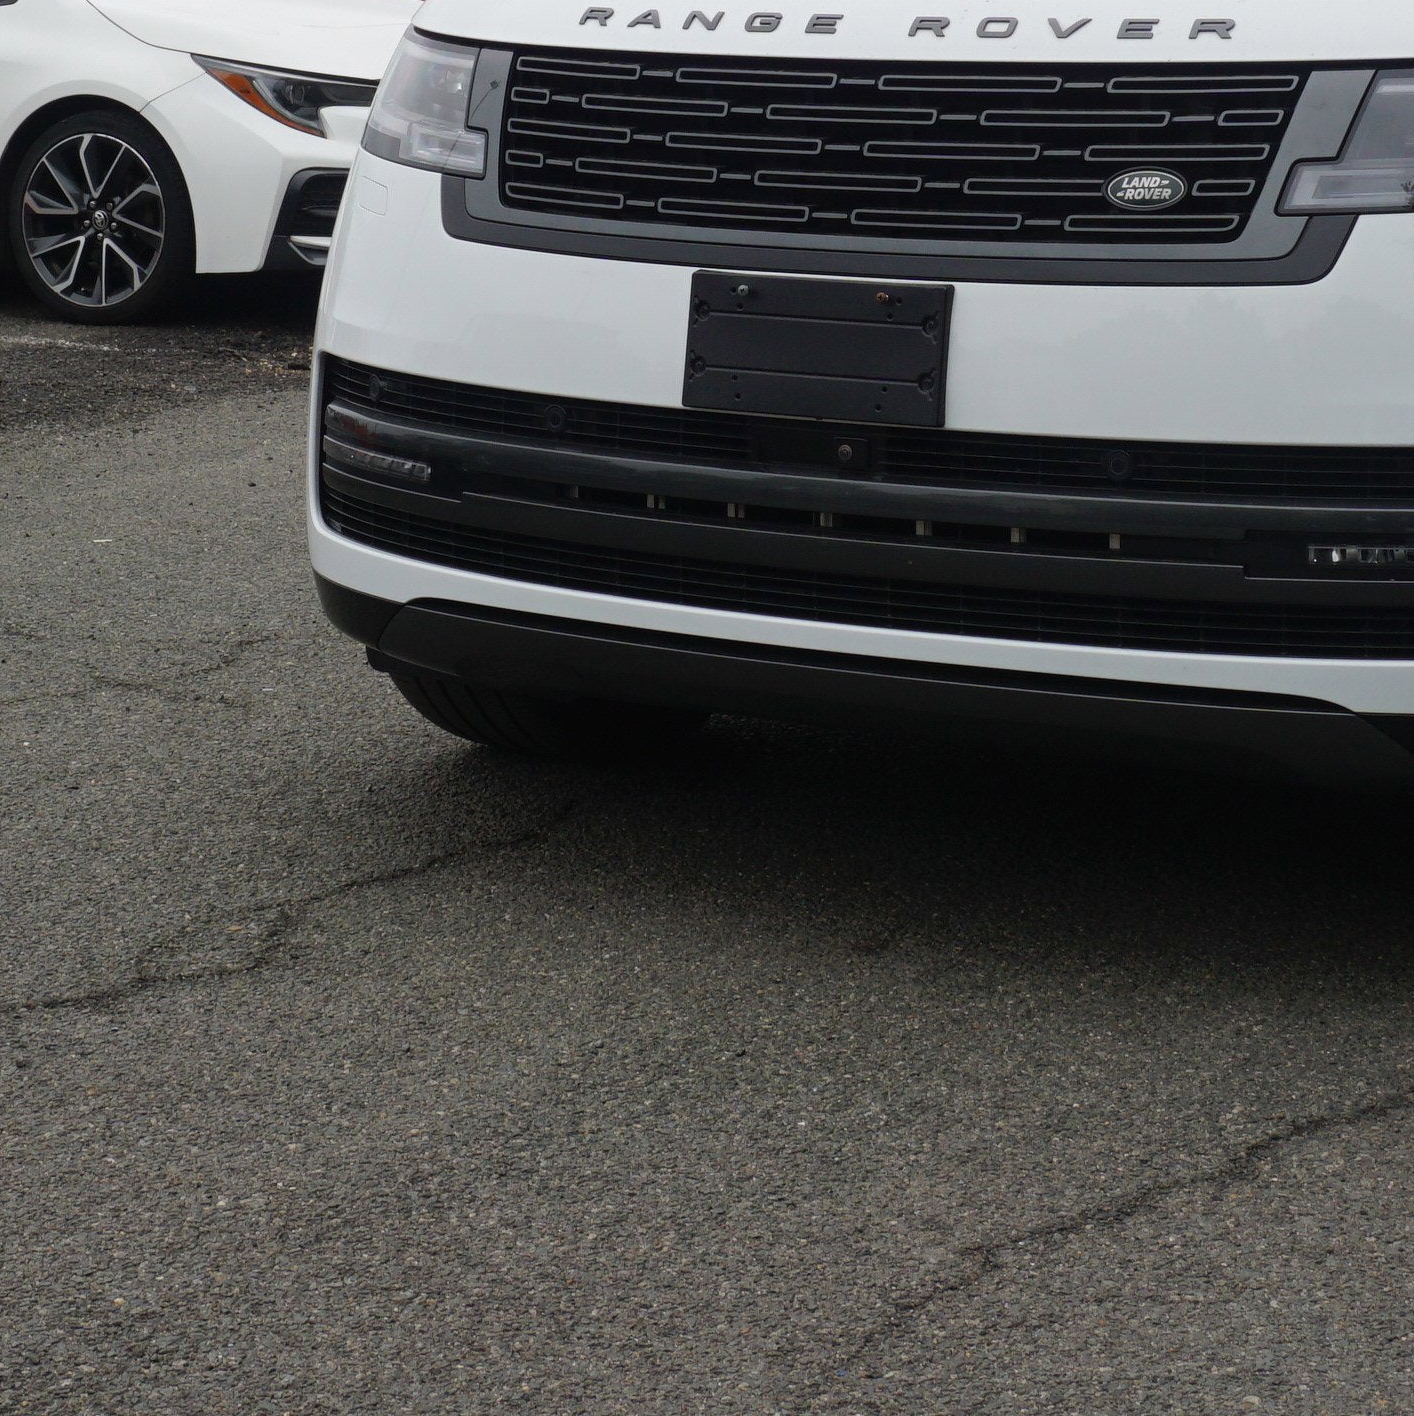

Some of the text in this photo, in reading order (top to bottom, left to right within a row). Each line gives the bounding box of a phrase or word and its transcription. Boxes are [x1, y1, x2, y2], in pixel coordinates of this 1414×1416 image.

[578, 5, 1237, 40] RANGE ROVER
[1121, 176, 1161, 188] LAND
[1124, 188, 1172, 200] ROVER
